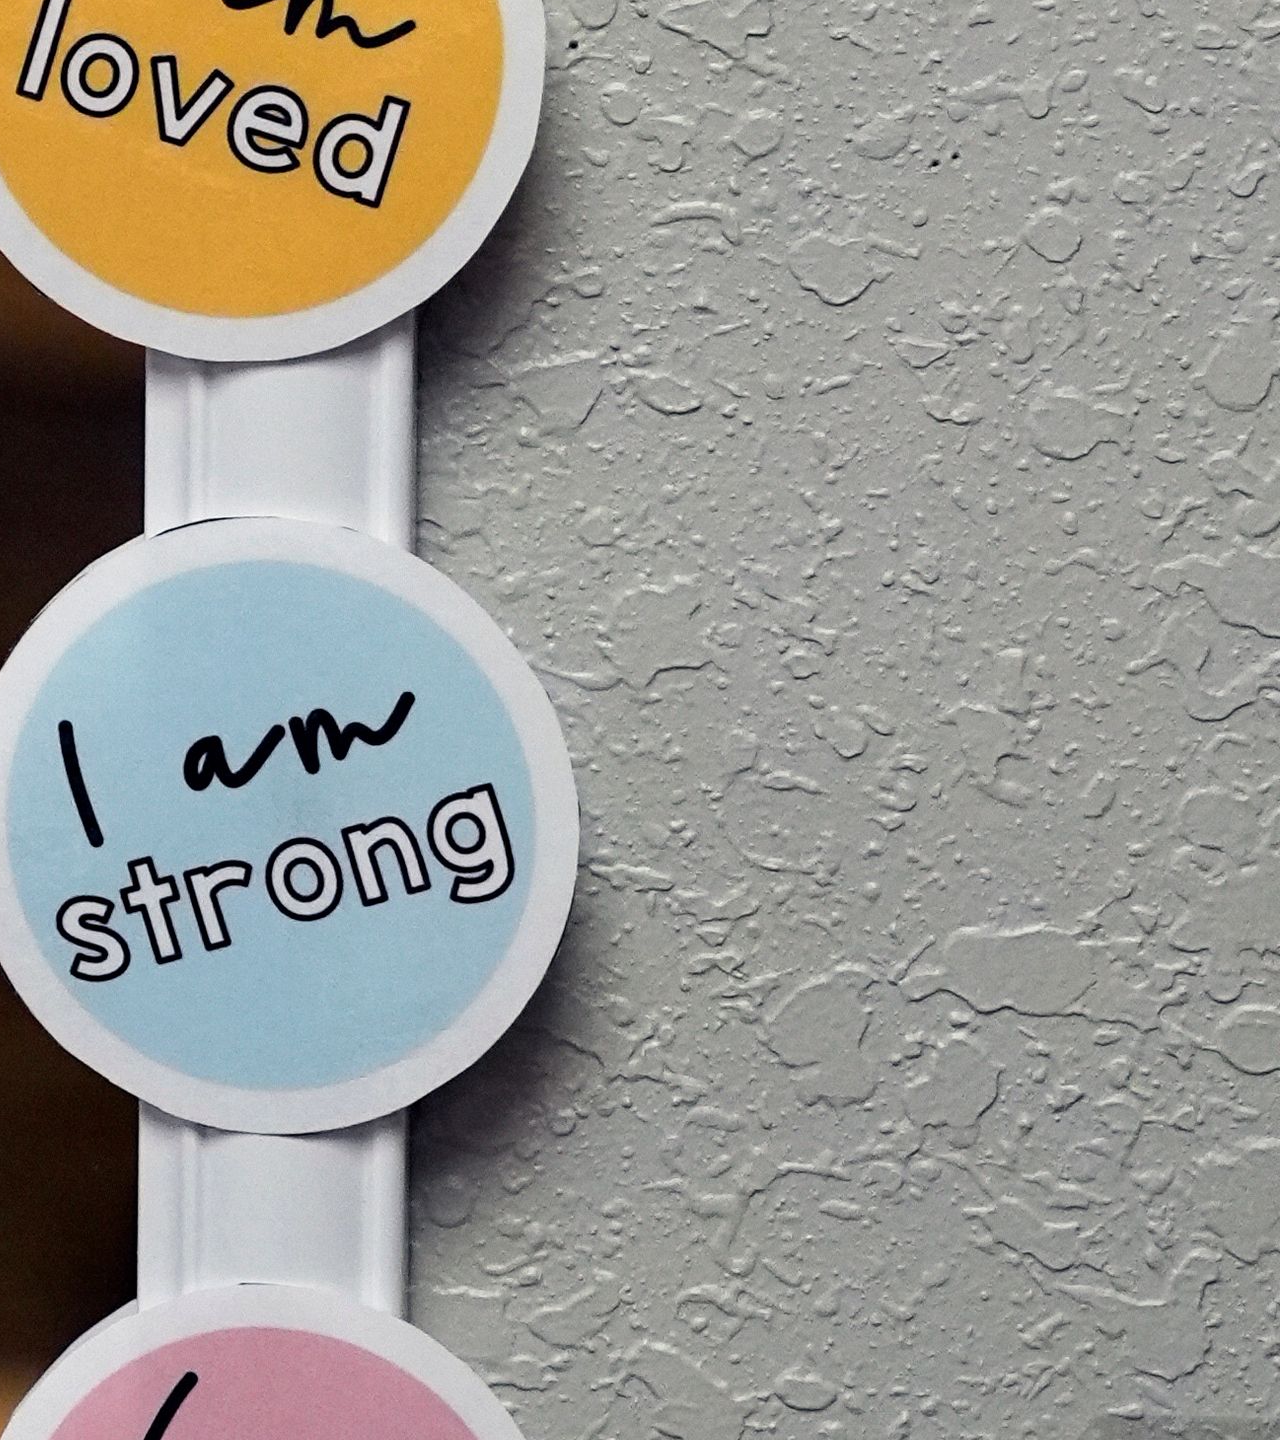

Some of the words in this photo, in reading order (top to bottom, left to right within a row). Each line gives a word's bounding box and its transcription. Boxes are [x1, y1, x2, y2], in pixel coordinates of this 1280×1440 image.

[58, 720, 104, 847] I
[184, 692, 415, 791] am
[56, 783, 515, 982] strong
